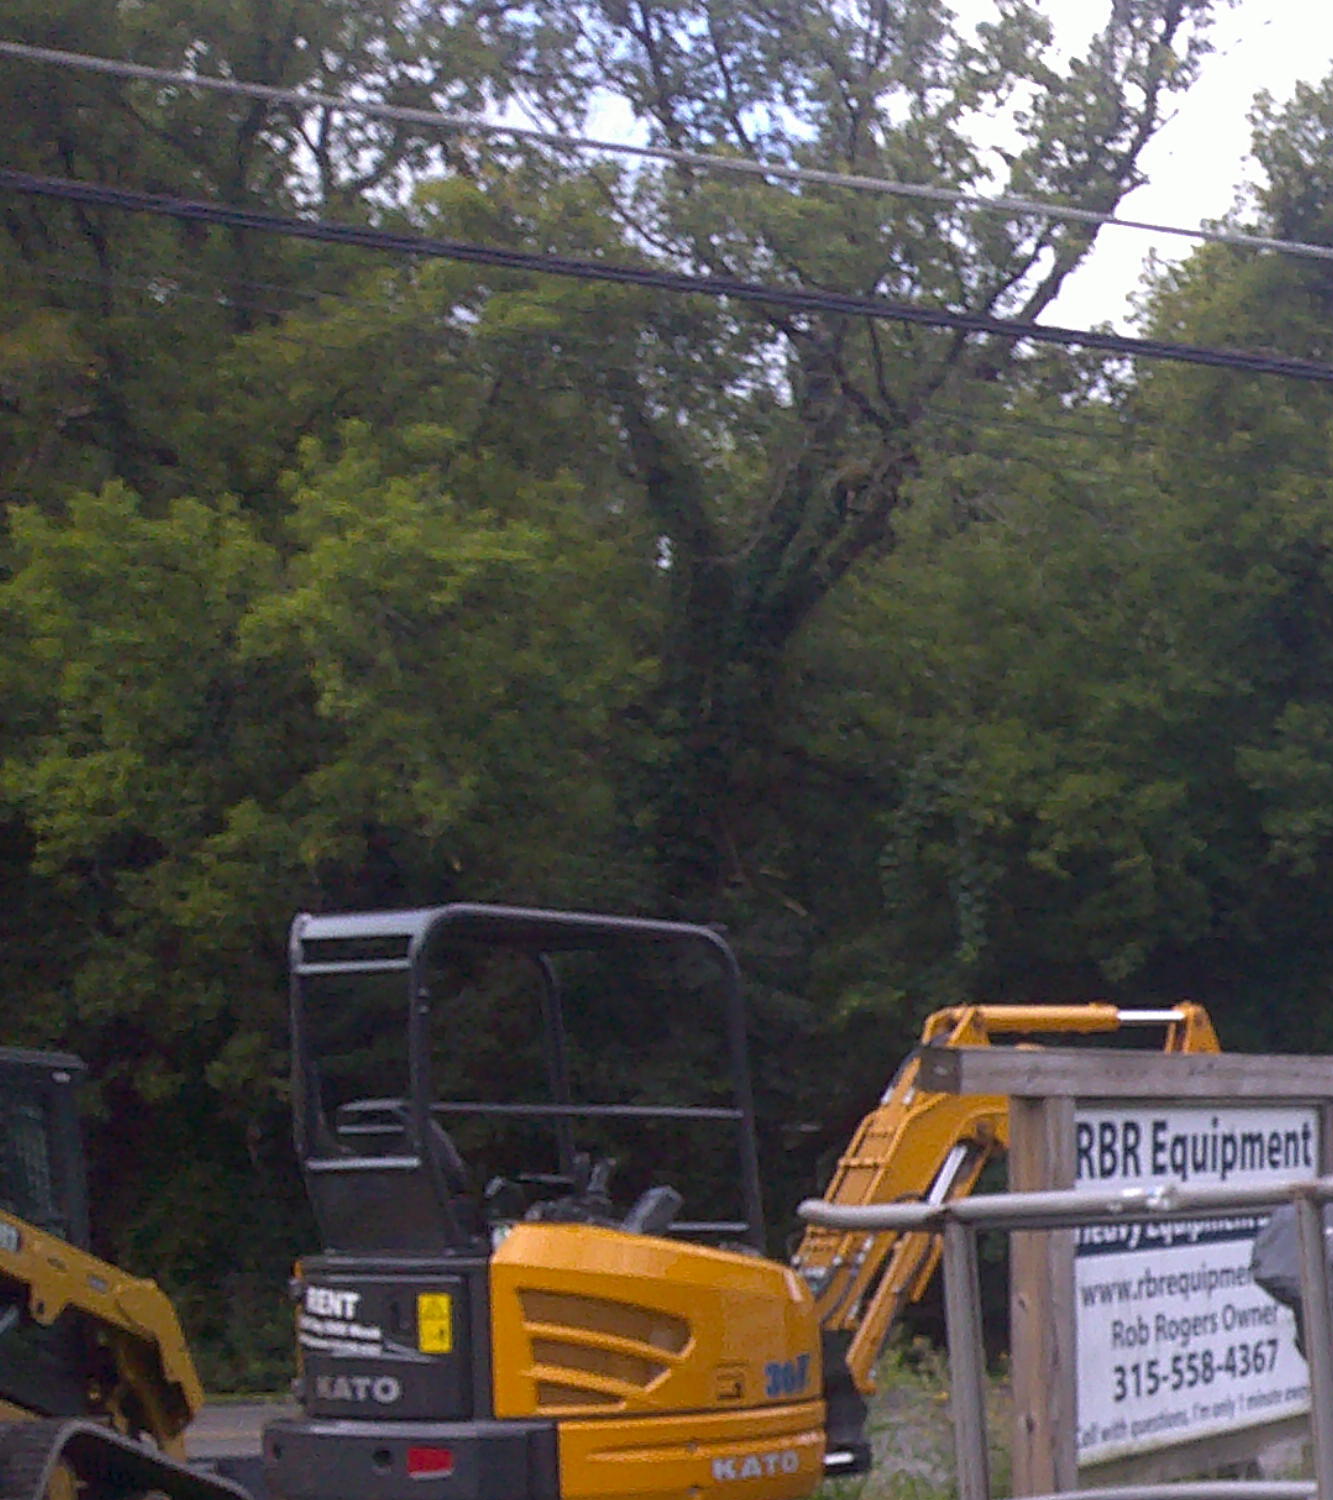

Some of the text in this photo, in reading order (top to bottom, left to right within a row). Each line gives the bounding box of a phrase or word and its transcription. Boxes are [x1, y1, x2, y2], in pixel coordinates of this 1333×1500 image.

[1075, 1116, 1312, 1182] RBR Equipment
[1111, 1303, 1279, 1351] Rob Rogers Owner
[315, 1374, 401, 1404] KATO
[1113, 1338, 1279, 1404] 315-558-4367
[711, 1450, 799, 1481] KATO
